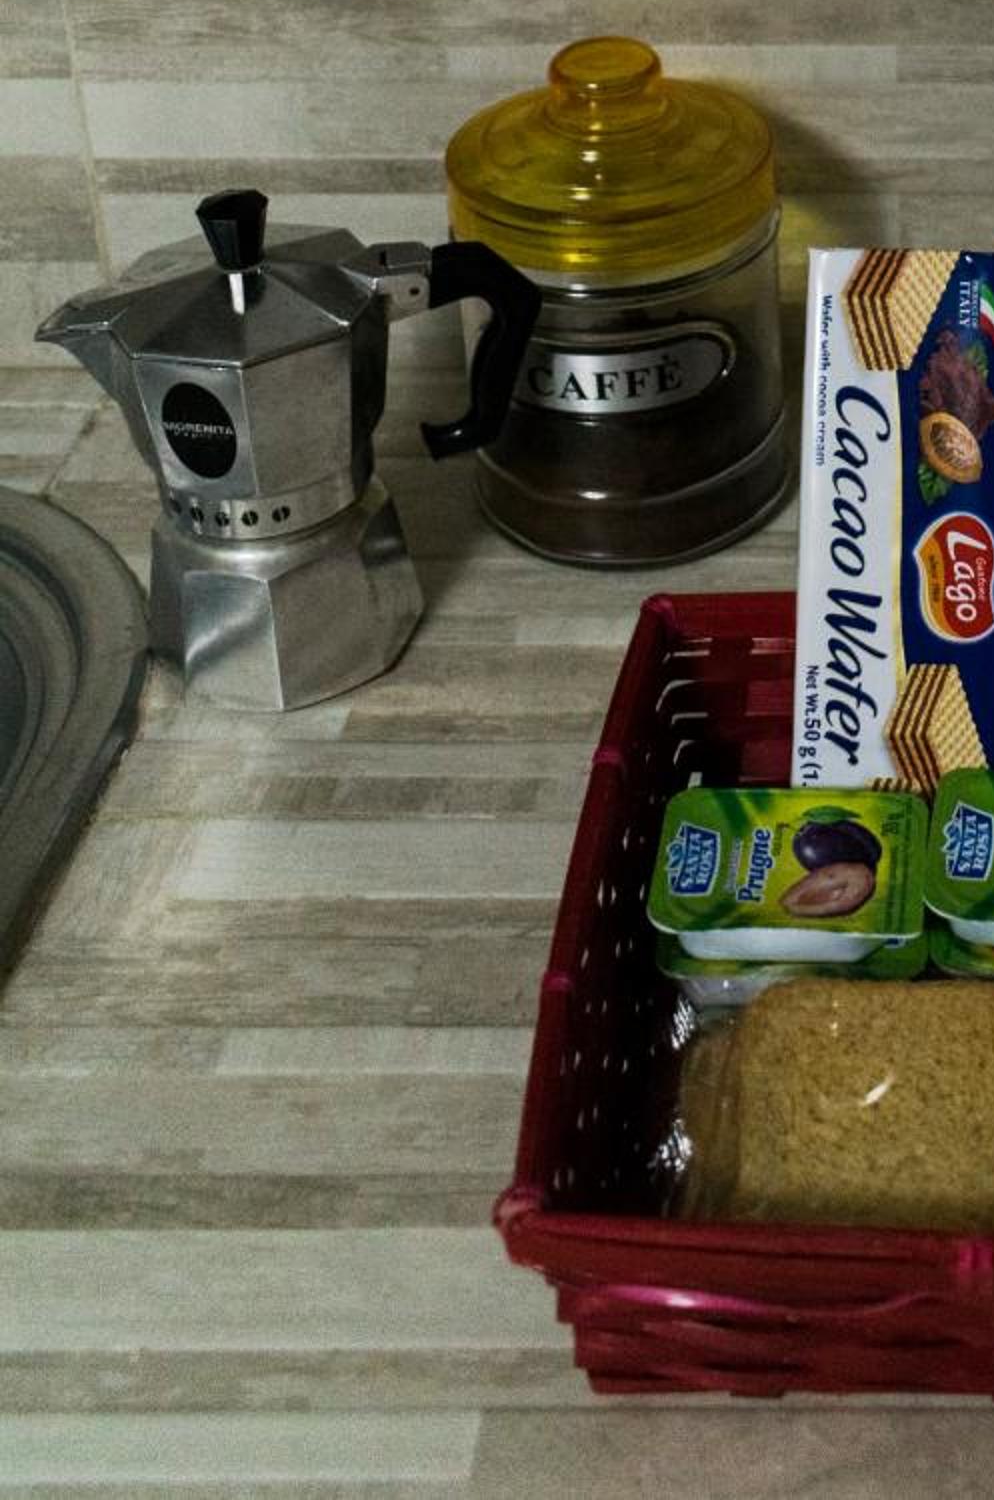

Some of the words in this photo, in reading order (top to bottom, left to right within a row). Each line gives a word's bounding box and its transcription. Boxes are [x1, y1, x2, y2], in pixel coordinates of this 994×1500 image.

[821, 295, 833, 335] Wafer
[959, 281, 971, 328] ITALY
[529, 357, 681, 400] CAFFÈ
[819, 340, 830, 371] with
[830, 386, 891, 577] Cacao
[946, 531, 988, 622] Lago
[806, 665, 819, 688] Net
[823, 589, 887, 766] Wafer
[798, 746, 817, 758] g
[677, 832, 701, 888] SANTA
[695, 838, 714, 885] ROSA
[737, 829, 773, 902] Prugne
[956, 815, 977, 874] SANTA
[972, 821, 990, 870] ROSA
